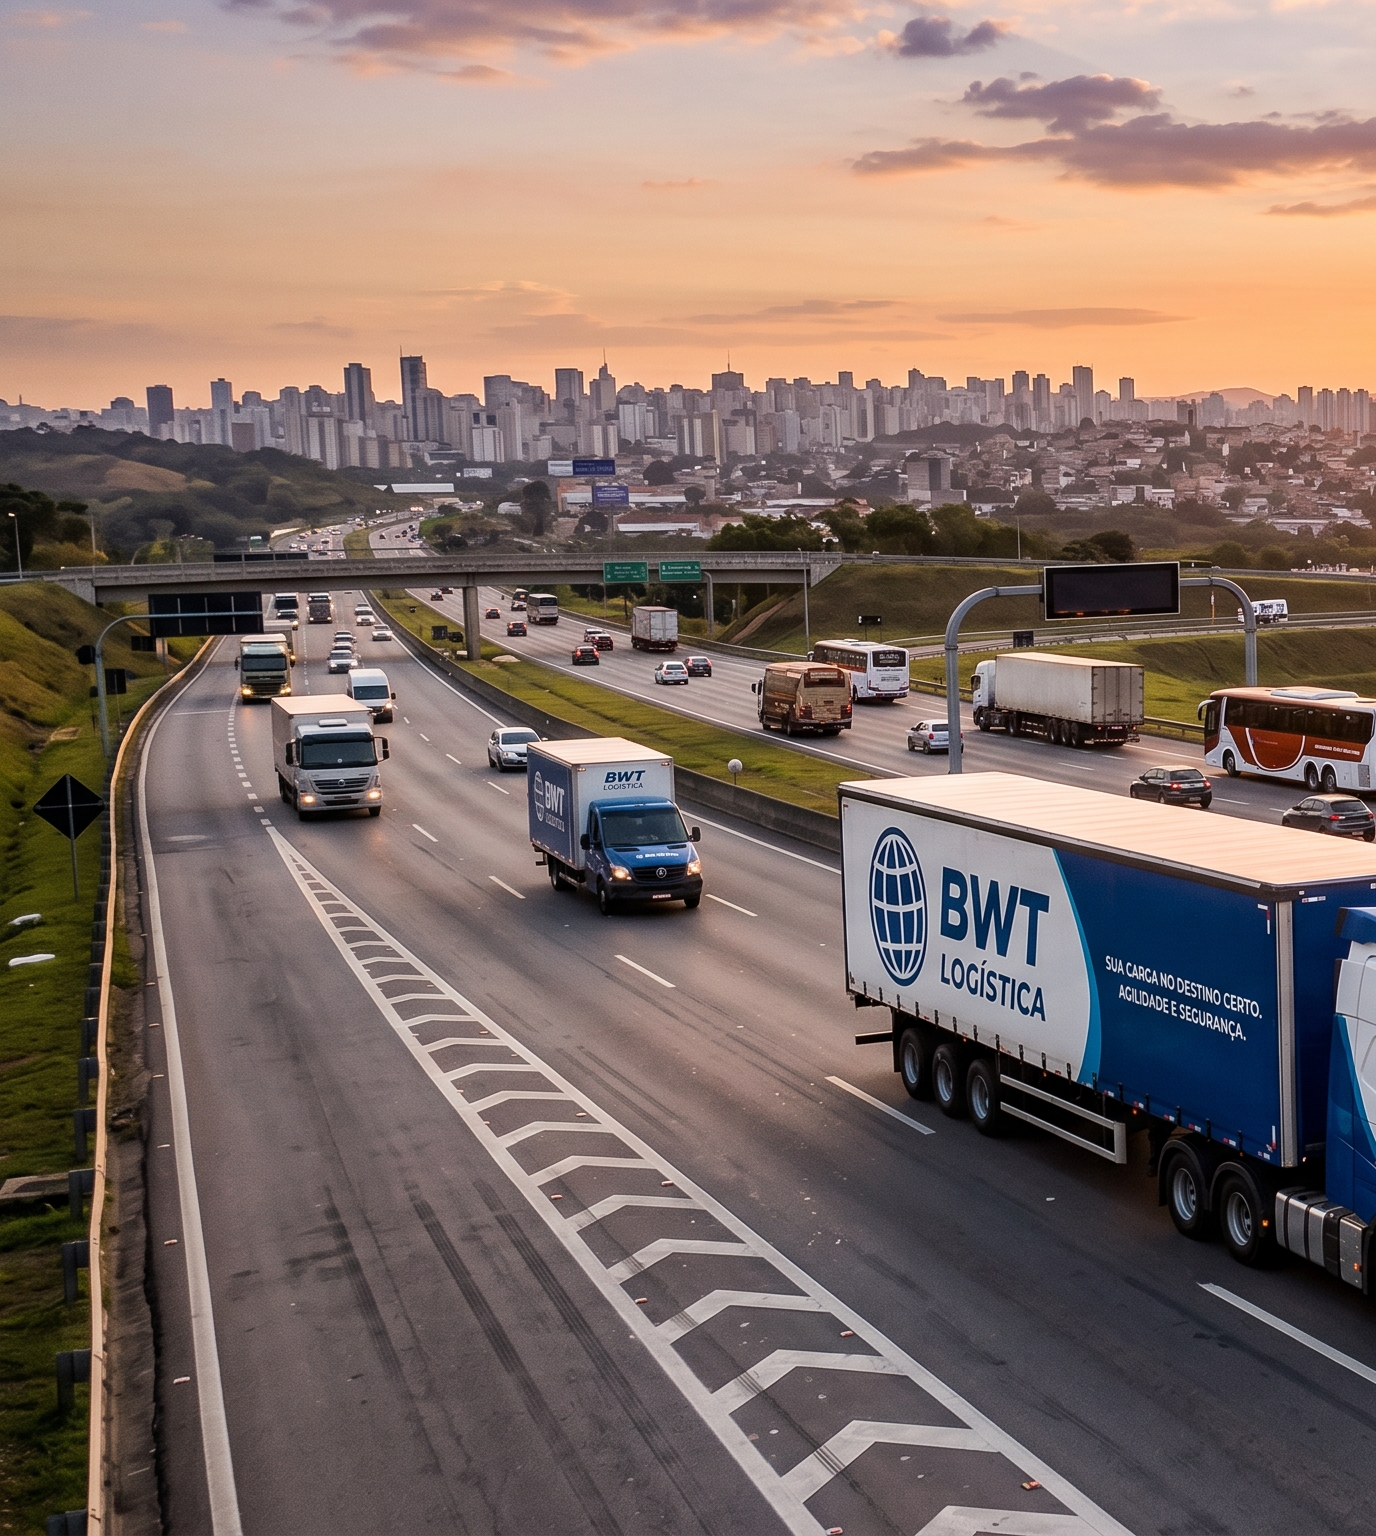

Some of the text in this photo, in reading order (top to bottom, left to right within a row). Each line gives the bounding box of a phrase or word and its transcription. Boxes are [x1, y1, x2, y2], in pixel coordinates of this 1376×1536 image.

[544, 780, 565, 817] BWT
[604, 770, 646, 783] BWT
[940, 866, 1050, 967] BWT
[940, 953, 1046, 1022] LOGÍSTICA
[1105, 955, 1263, 1019] SUA CARGA NO DESTINO CERTO.
[1118, 984, 1247, 1042] AGILIDADE E SEGURANÇA.
